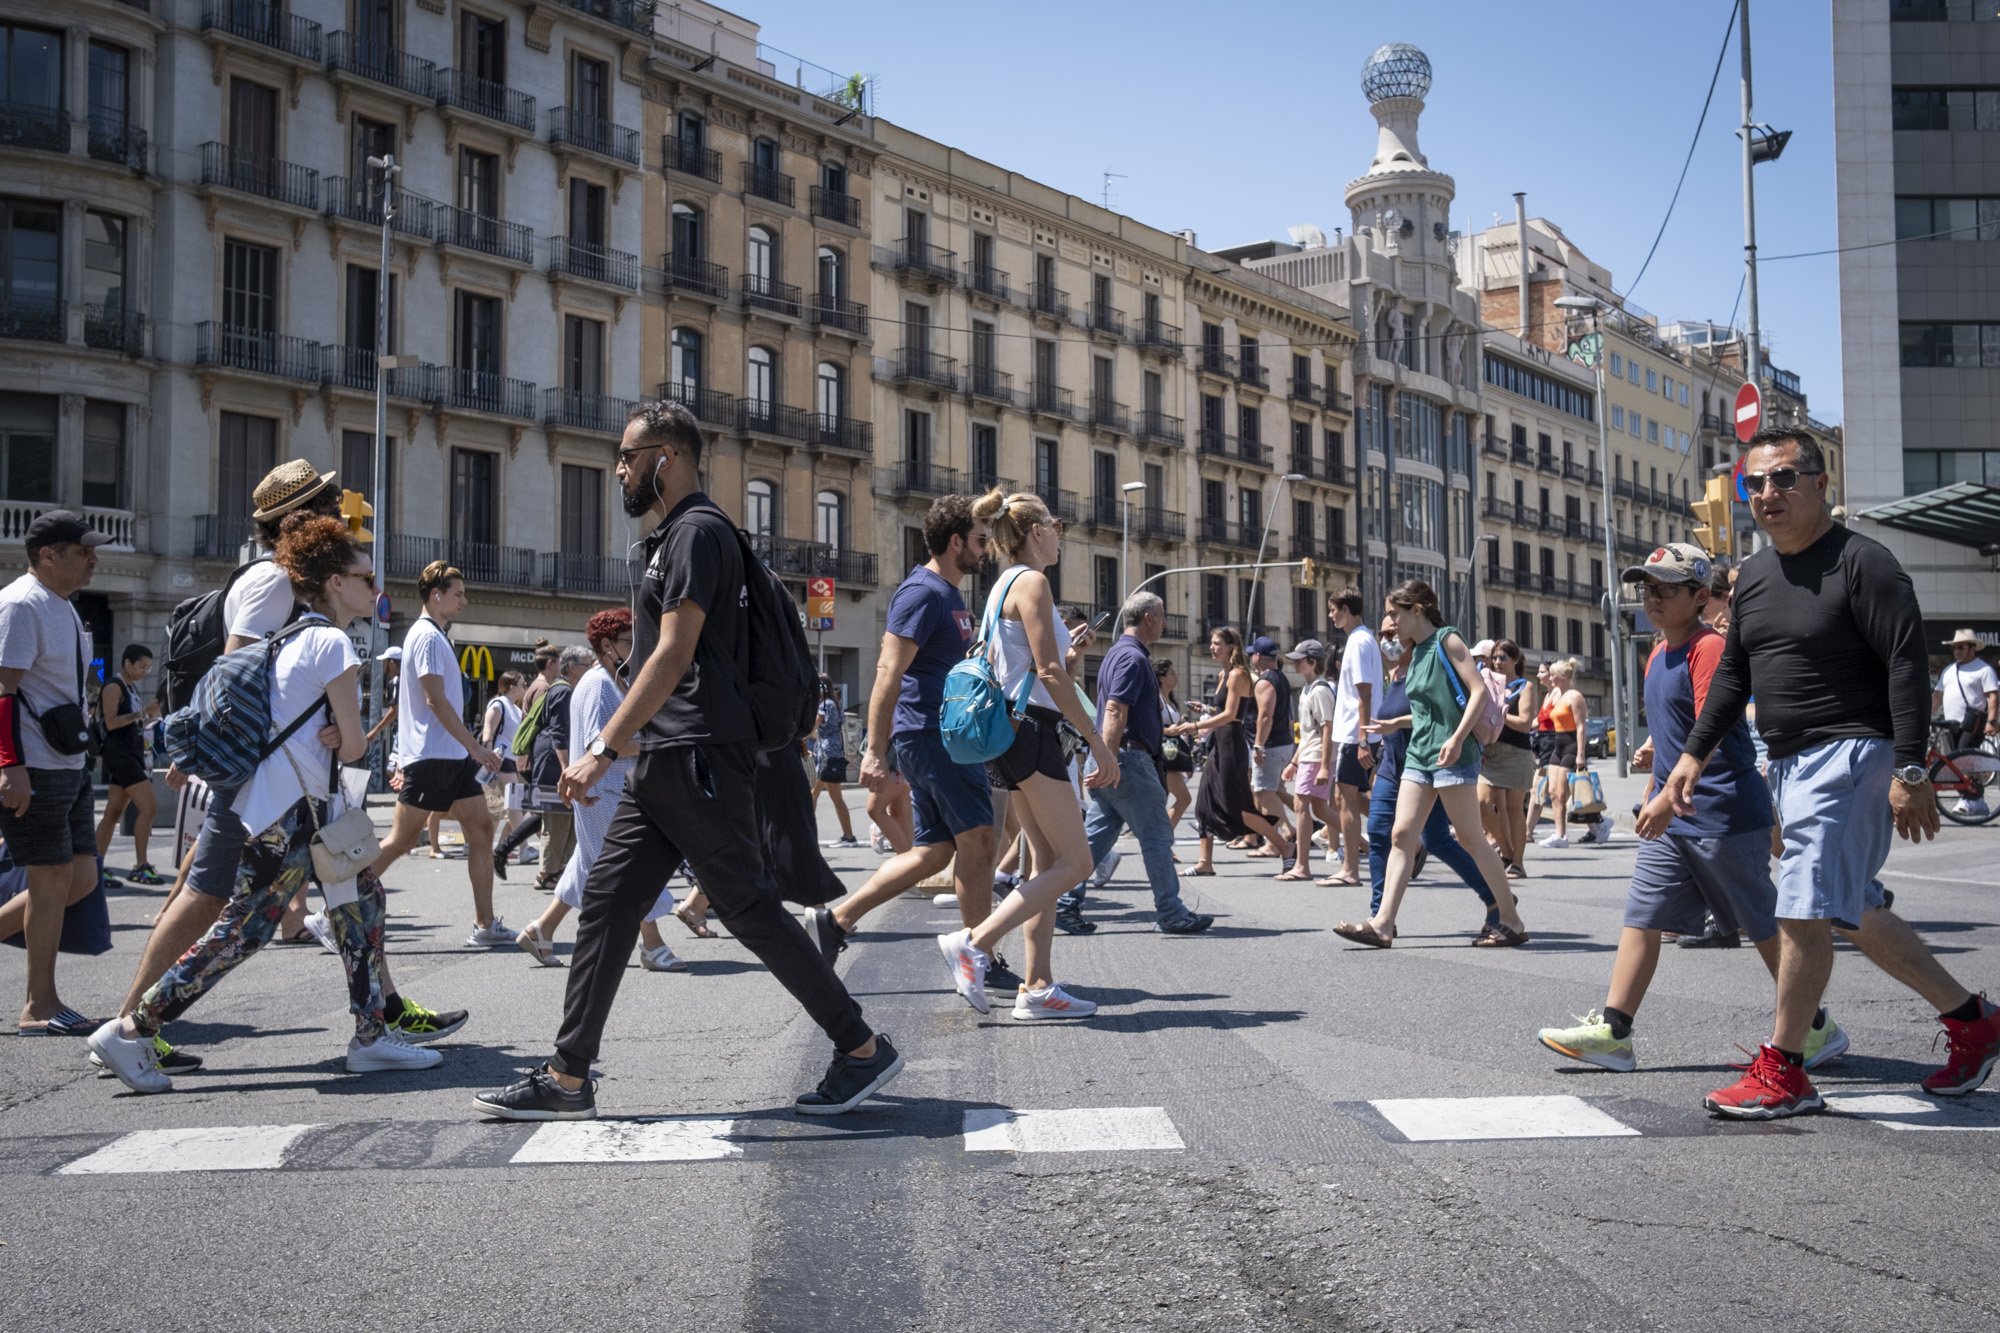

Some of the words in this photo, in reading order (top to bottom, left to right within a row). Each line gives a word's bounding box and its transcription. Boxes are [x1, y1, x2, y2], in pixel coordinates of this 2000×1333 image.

[740, 585, 748, 599] A
[349, 636, 367, 645] TEL
[510, 651, 535, 663] McD
